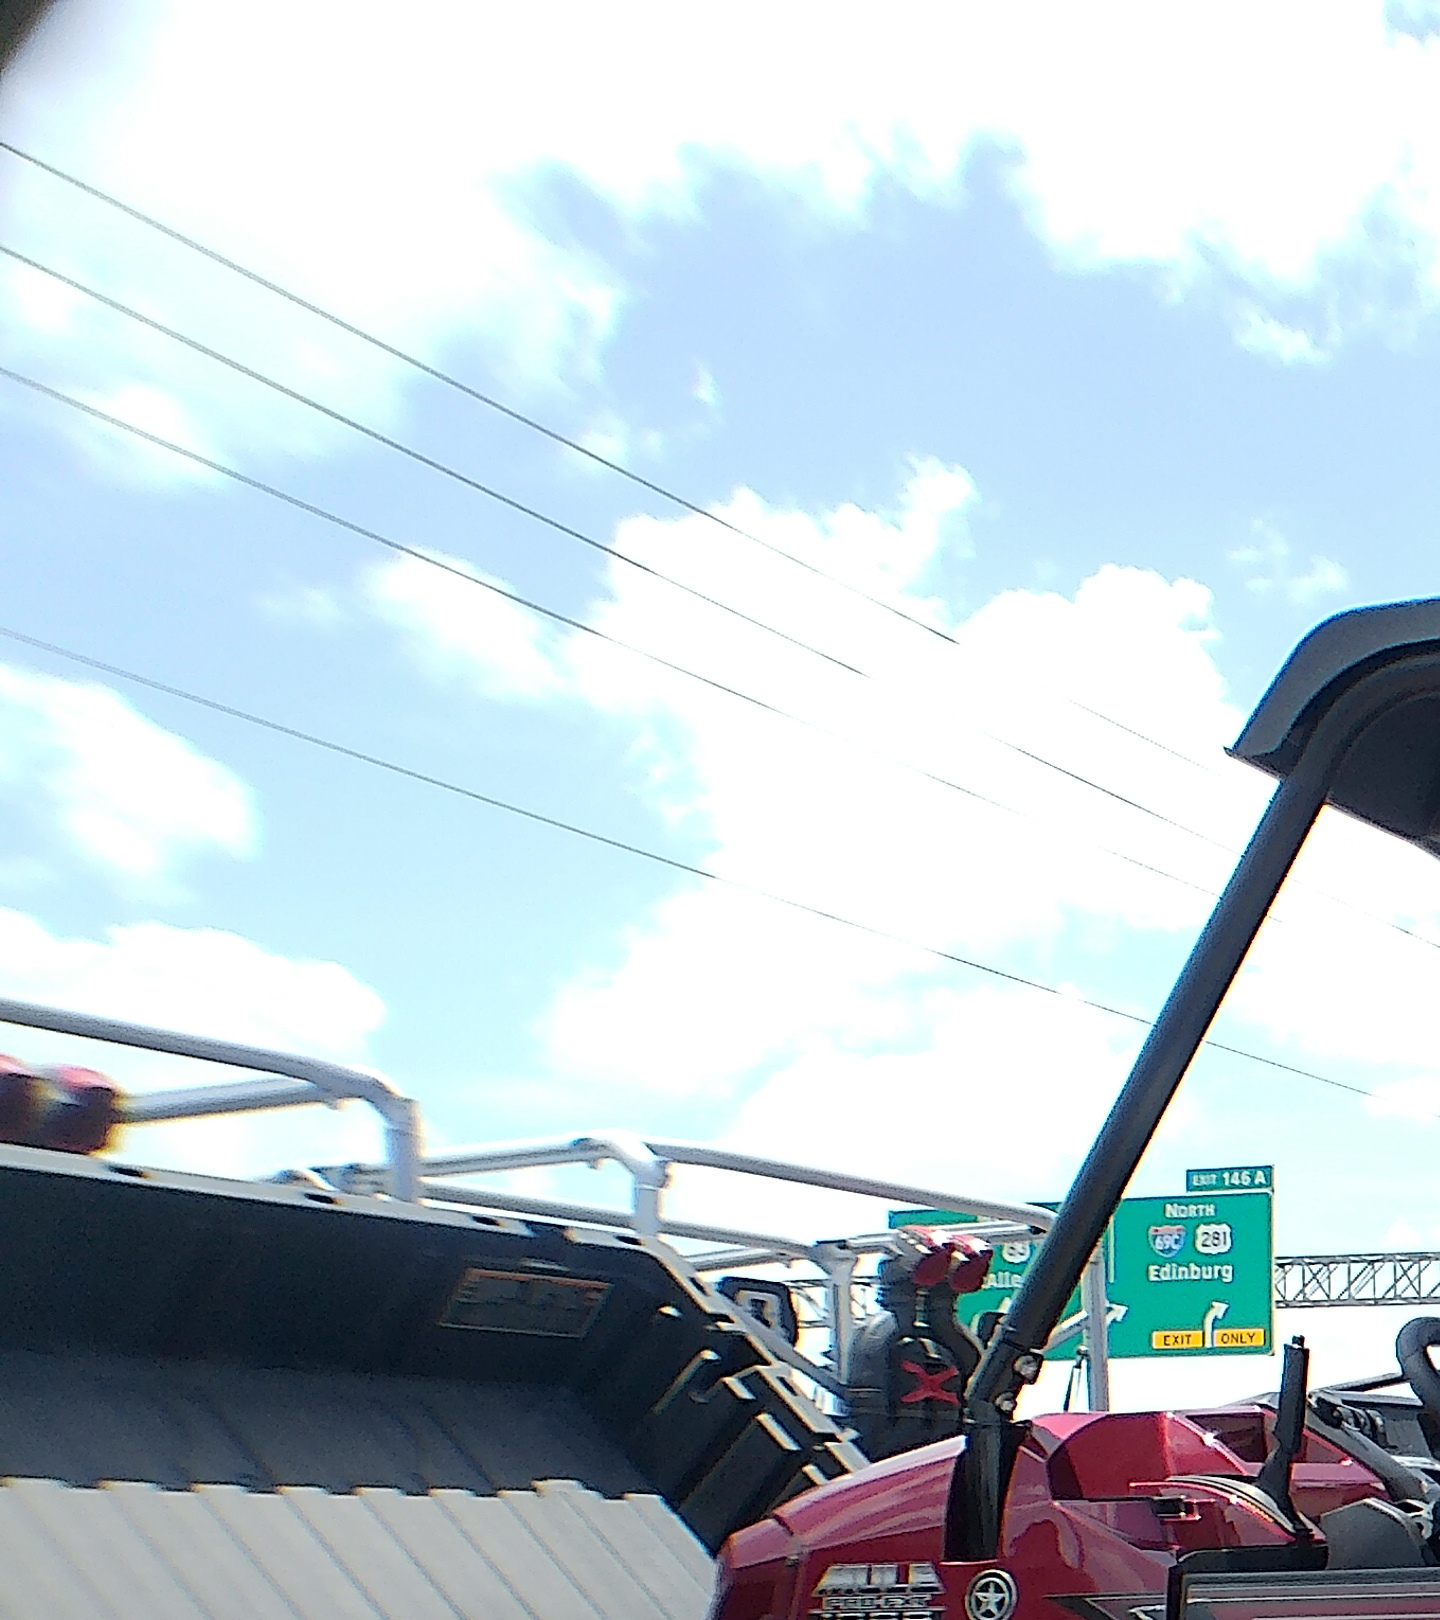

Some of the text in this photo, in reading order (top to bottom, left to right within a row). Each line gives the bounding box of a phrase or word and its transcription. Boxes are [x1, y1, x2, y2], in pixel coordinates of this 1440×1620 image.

[1192, 1170, 1267, 1186] EXIT 146 A
[1201, 1230, 1227, 1248] 281
[1148, 1262, 1234, 1283] Edinburg
[1163, 1331, 1256, 1346] EXIT ONLY
